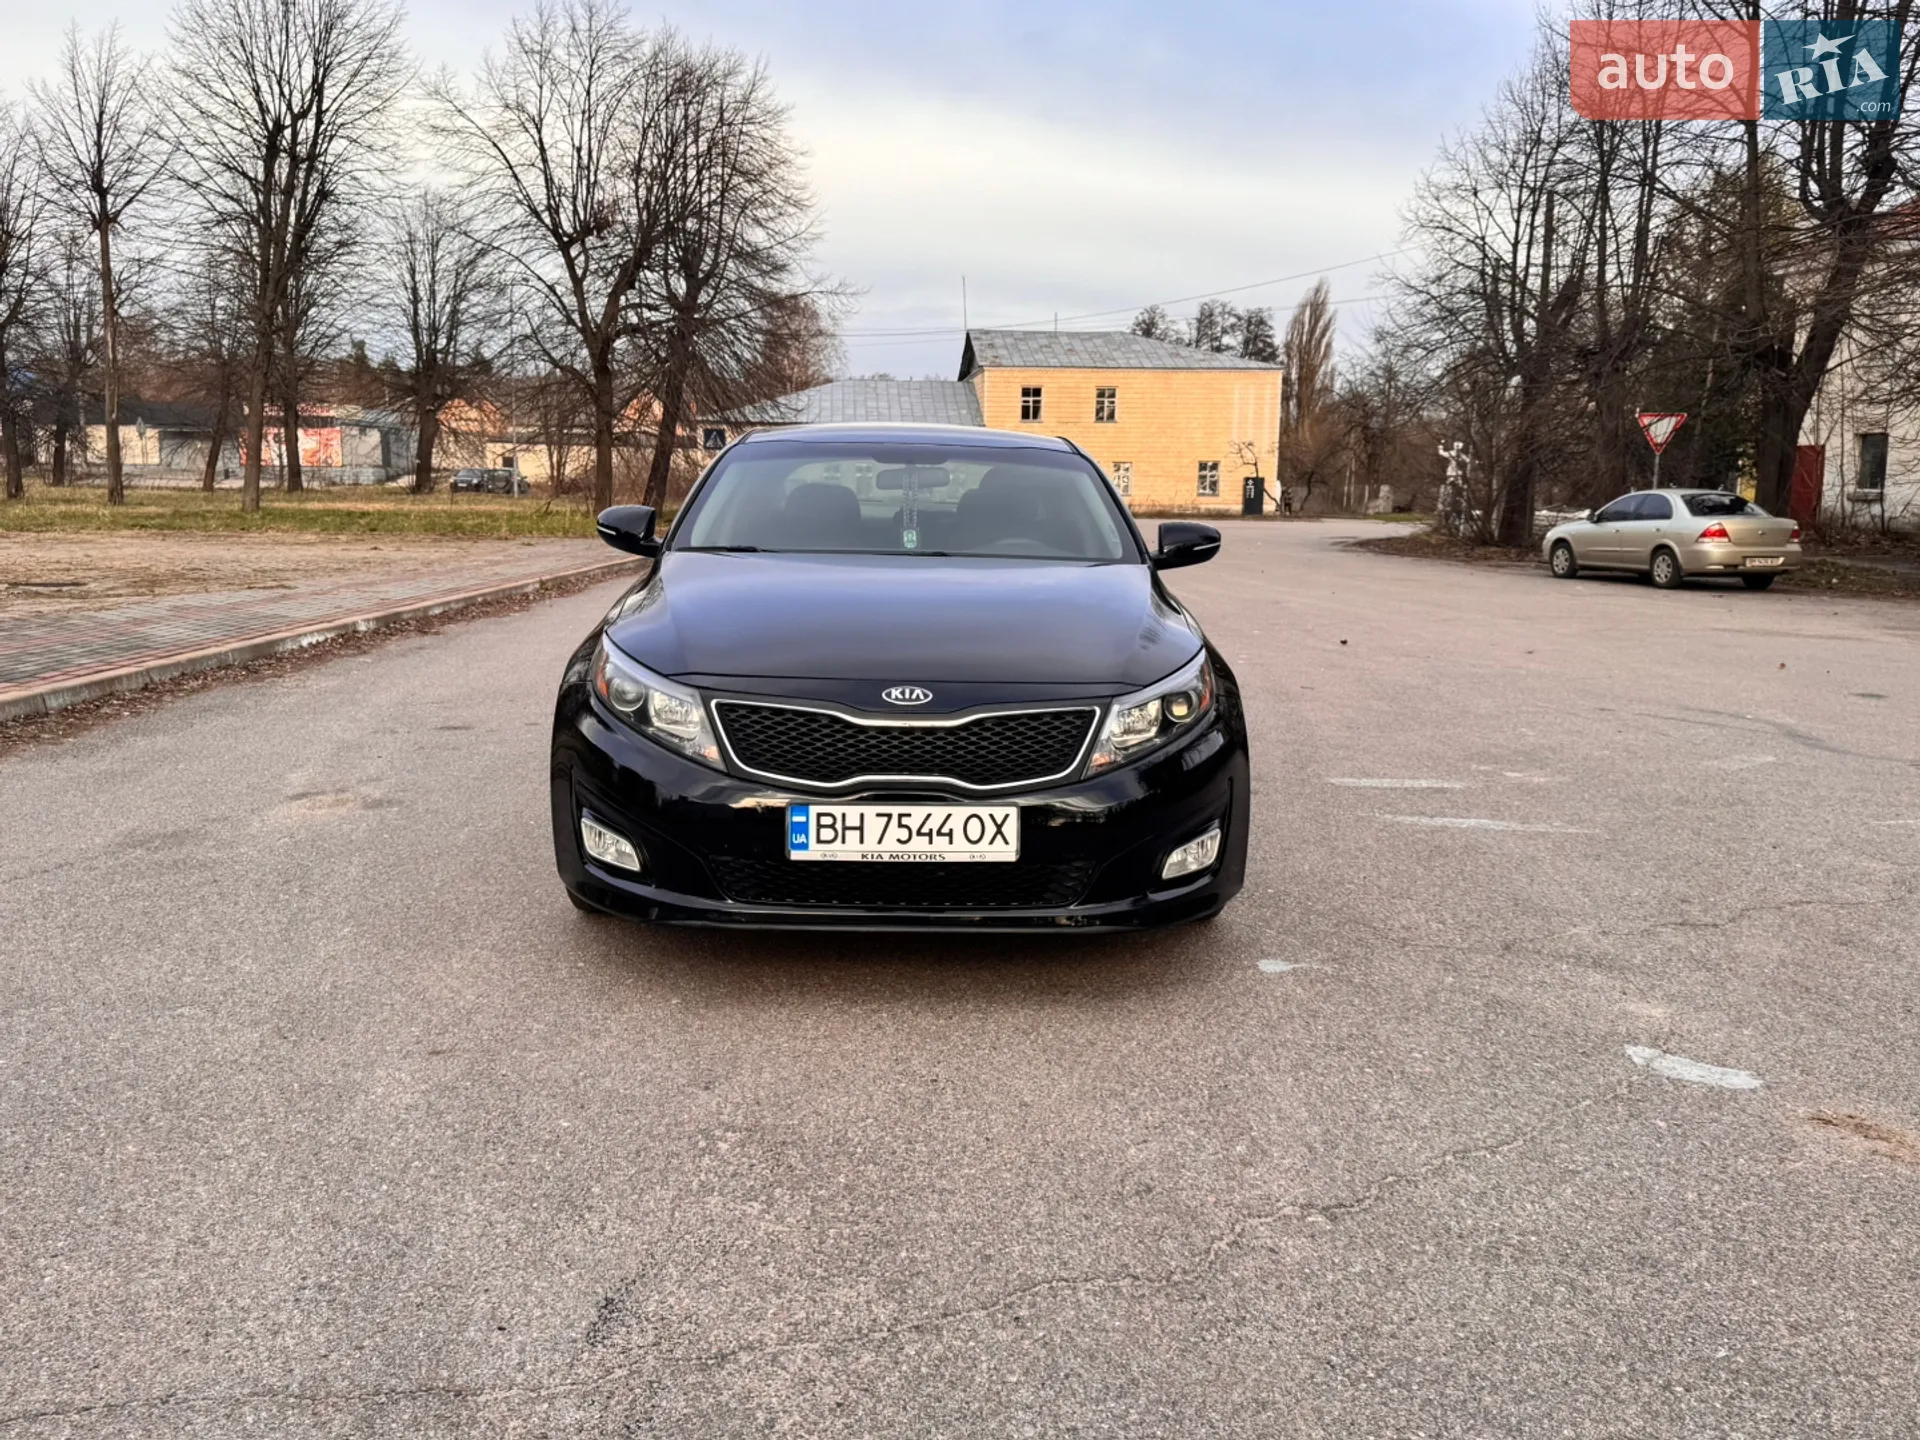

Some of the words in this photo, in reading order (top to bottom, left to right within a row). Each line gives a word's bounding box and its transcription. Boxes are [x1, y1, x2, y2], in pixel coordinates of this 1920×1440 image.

[891, 688, 925, 700] KIA
[815, 812, 865, 845] BH
[875, 813, 954, 845] 7544
[963, 813, 1010, 845] OX
[792, 834, 807, 844] UA
[888, 853, 946, 861] MOTORS
